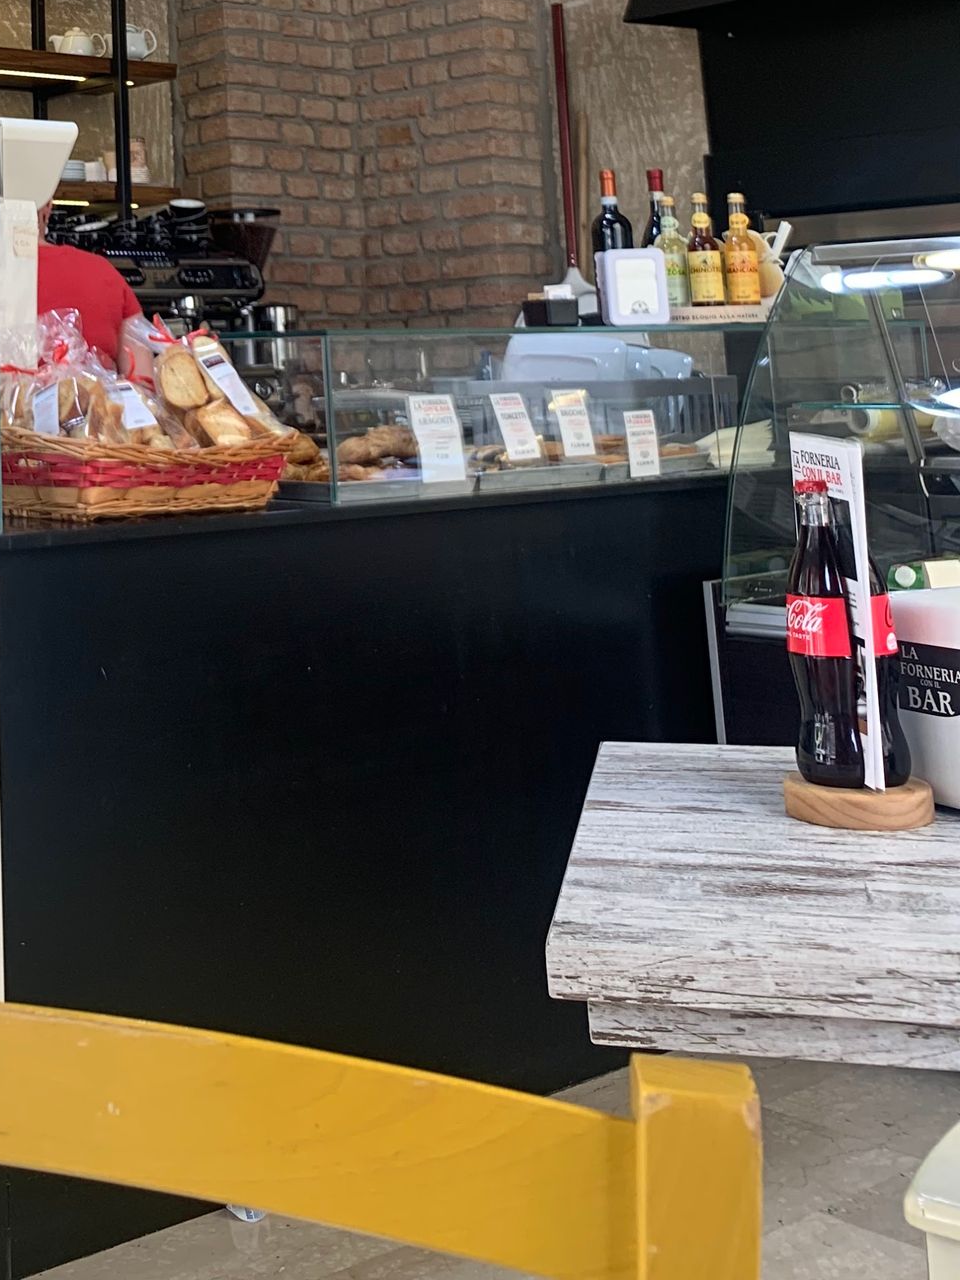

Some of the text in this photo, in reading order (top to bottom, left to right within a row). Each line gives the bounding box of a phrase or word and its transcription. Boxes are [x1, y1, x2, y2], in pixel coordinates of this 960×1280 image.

[793, 450, 840, 471] LA FORNERIA
[802, 466, 817, 481] CON
[826, 471, 842, 485] BAR
[901, 644, 919, 660] LA
[900, 661, 960, 684] FORNERIA
[919, 678, 941, 689] CON IL
[907, 685, 956, 715] BAR
